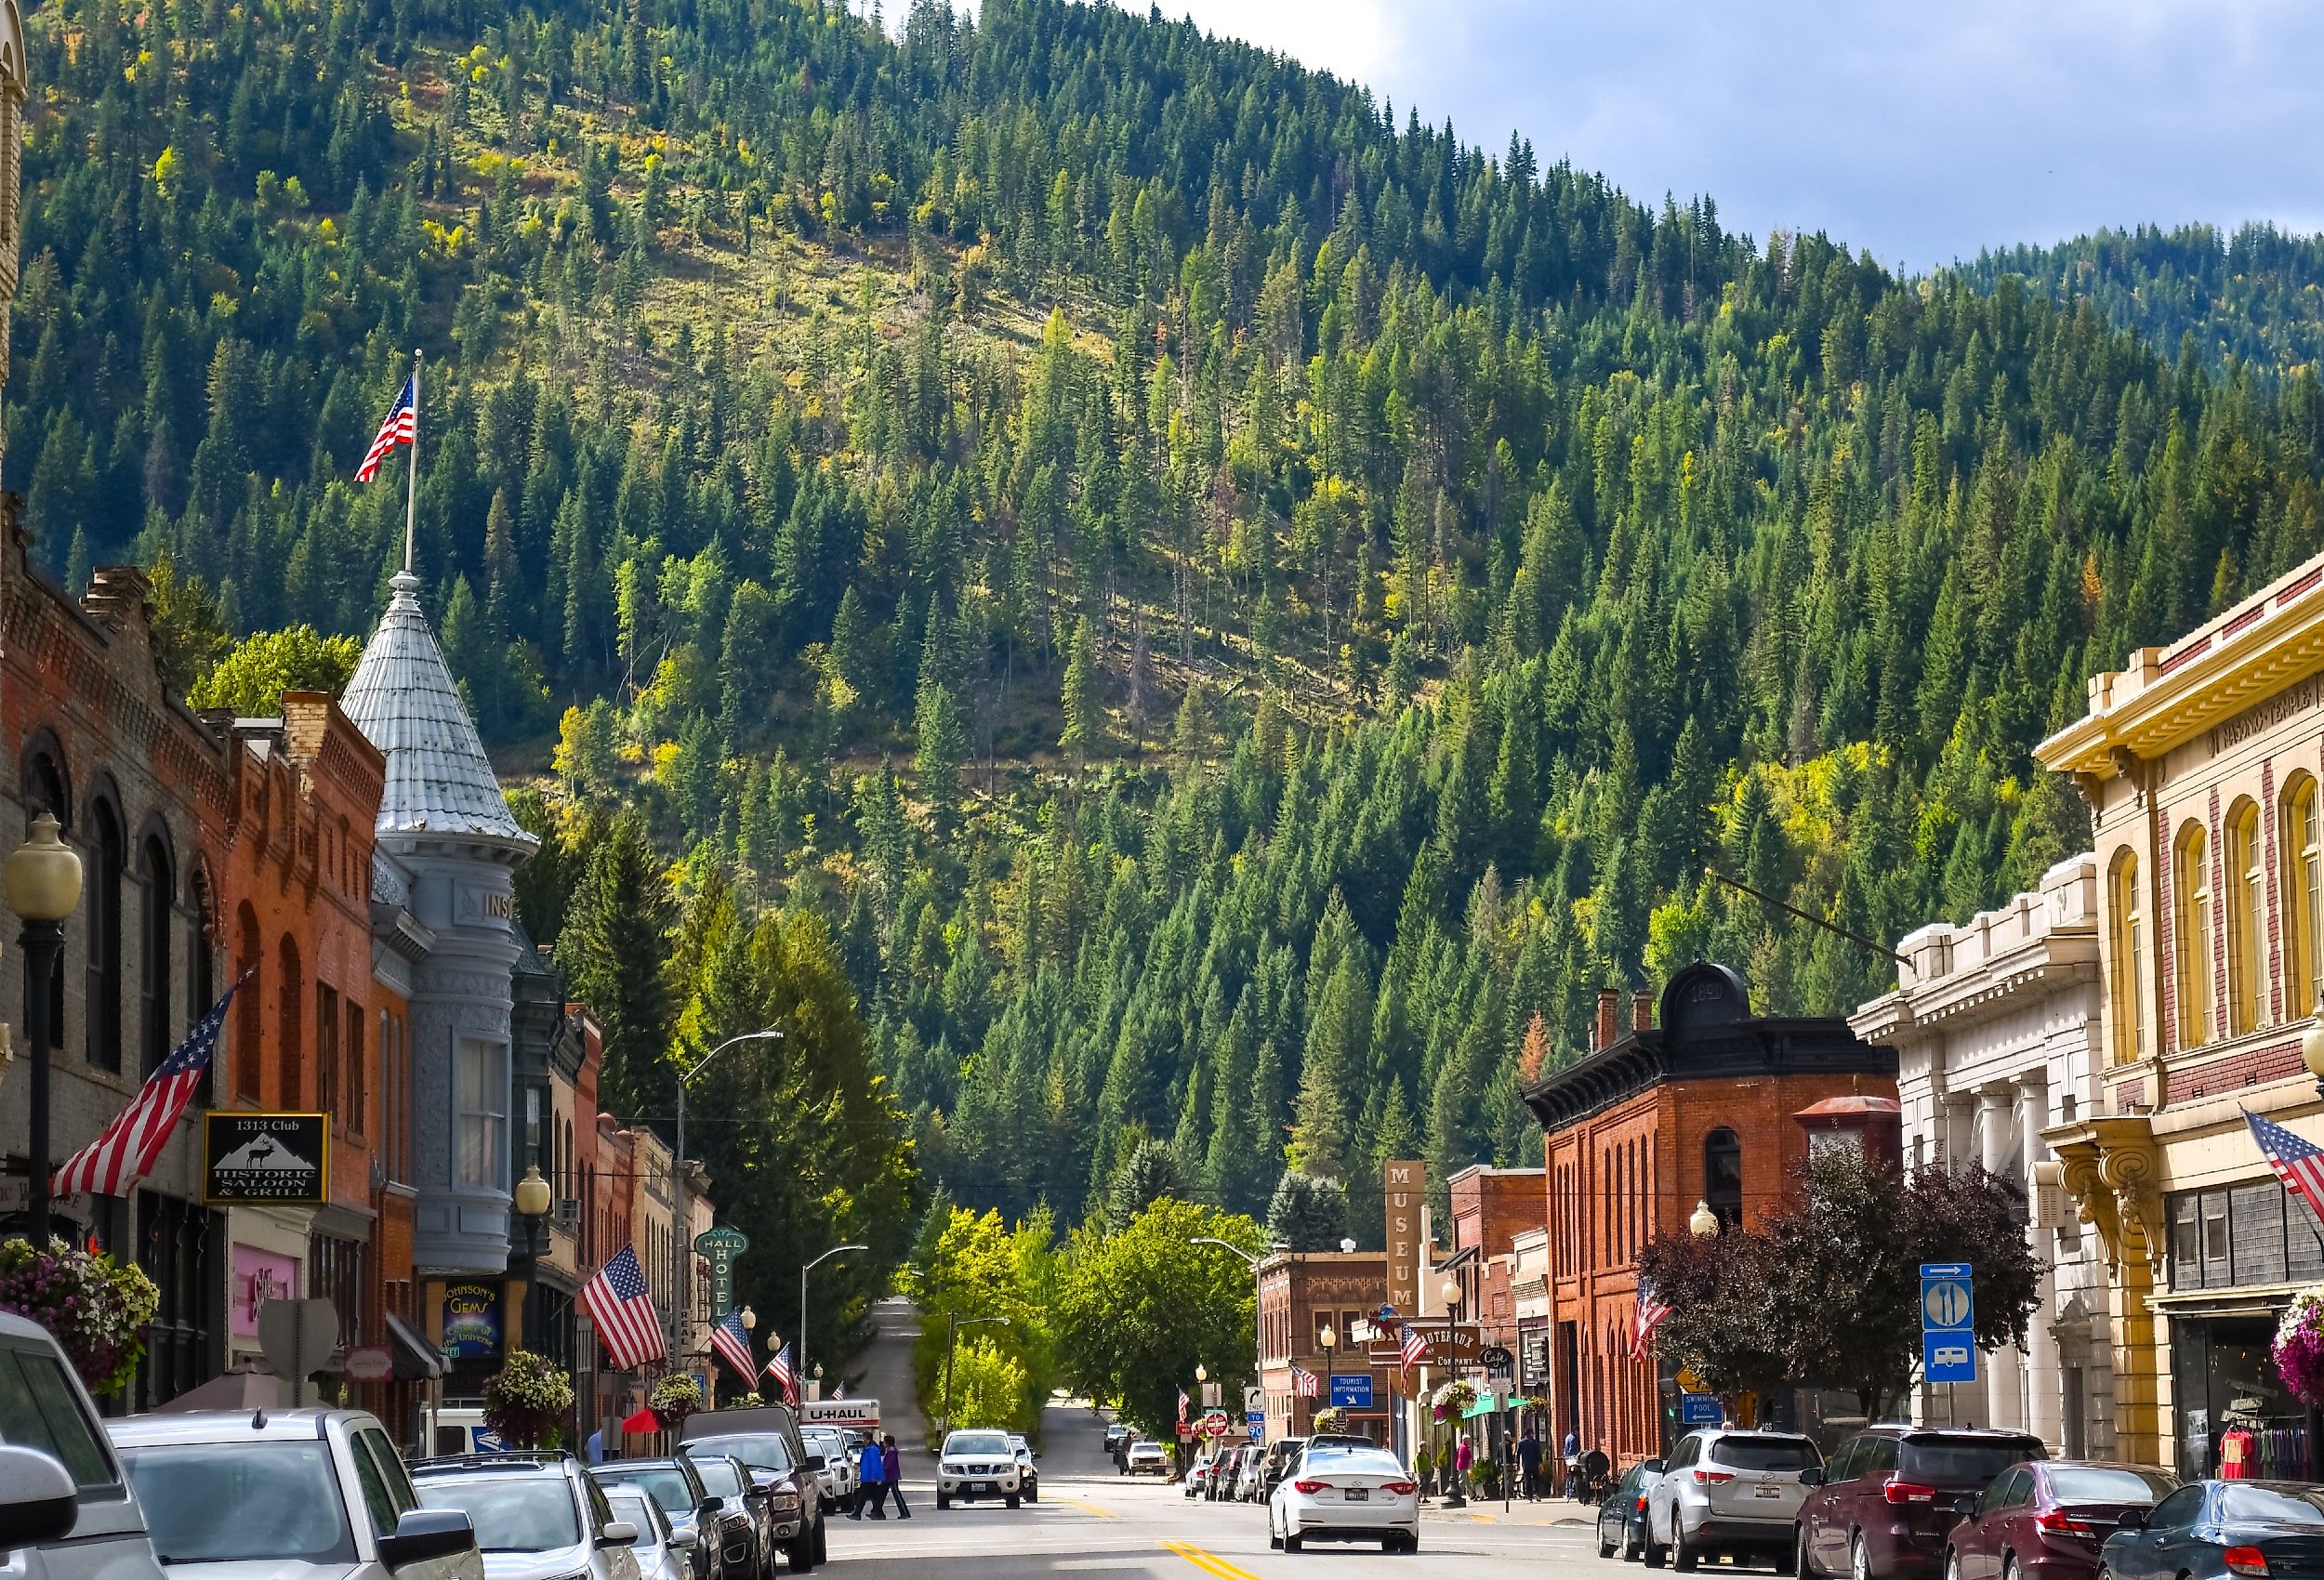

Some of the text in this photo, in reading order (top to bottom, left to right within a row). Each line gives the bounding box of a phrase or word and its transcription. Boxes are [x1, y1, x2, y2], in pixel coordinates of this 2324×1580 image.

[2268, 686, 2311, 725] TEMPLE
[236, 1121, 299, 1131] 1313 Club
[214, 1170, 315, 1178] HISTORIC
[221, 1179, 307, 1188] SALOON
[1391, 1168, 1412, 1306] MUSEUM
[705, 1240, 741, 1248] HALL
[715, 1250, 728, 1317] HOTEL
[442, 1285, 495, 1302] JOHNSON'S
[680, 1311, 689, 1346] REAL
[442, 1338, 457, 1349] the
[810, 1409, 866, 1420] U-HAUL
[1248, 1426, 1263, 1437] 90
